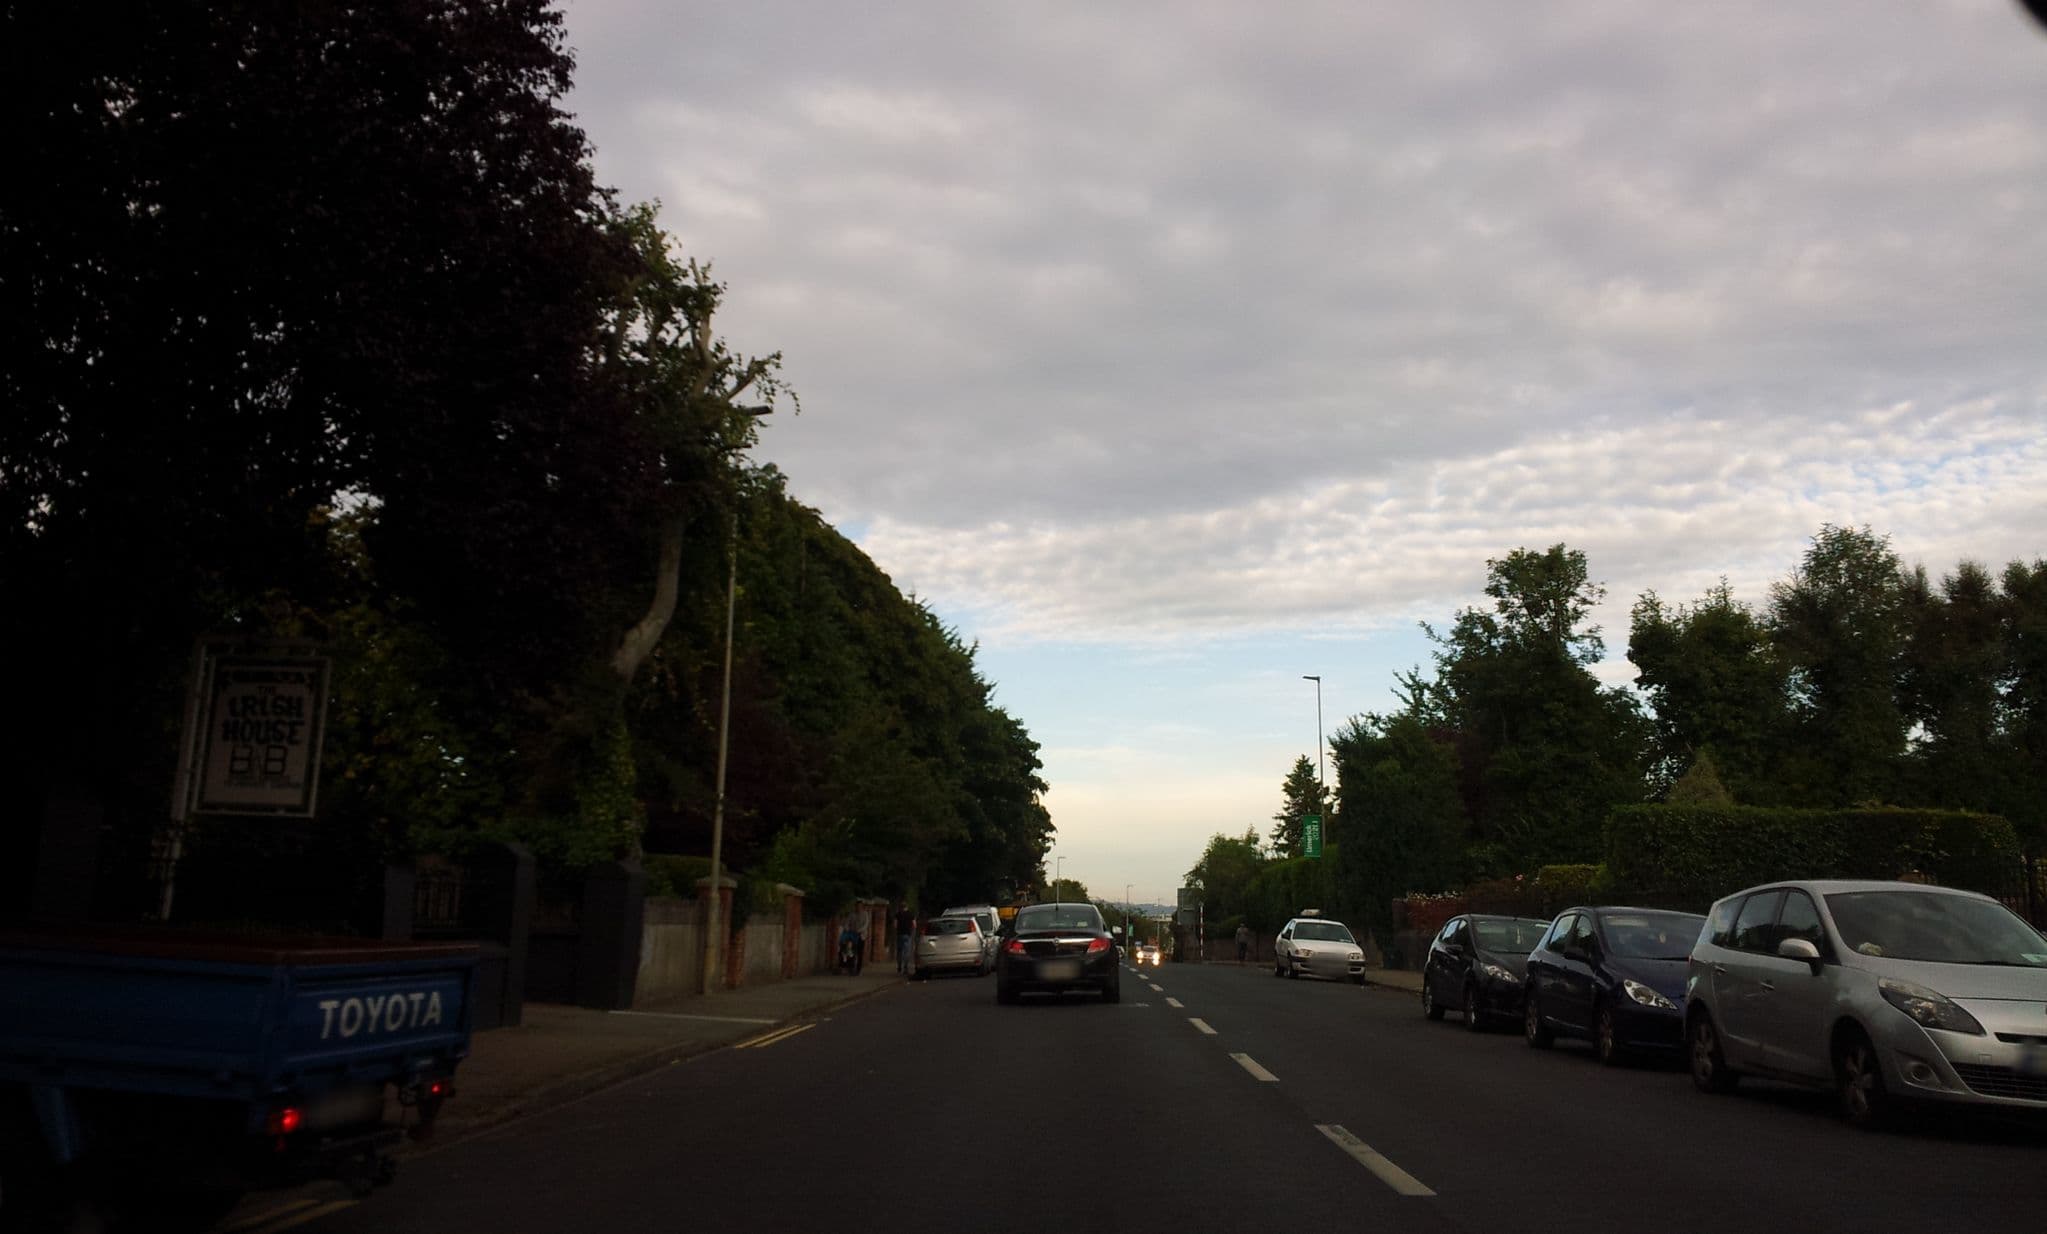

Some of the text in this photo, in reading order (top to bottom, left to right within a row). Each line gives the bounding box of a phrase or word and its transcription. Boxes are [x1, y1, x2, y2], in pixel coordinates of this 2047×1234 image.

[229, 695, 305, 716] IRISH
[223, 719, 305, 744] HOUSE
[318, 991, 444, 1040] TOYOTA
